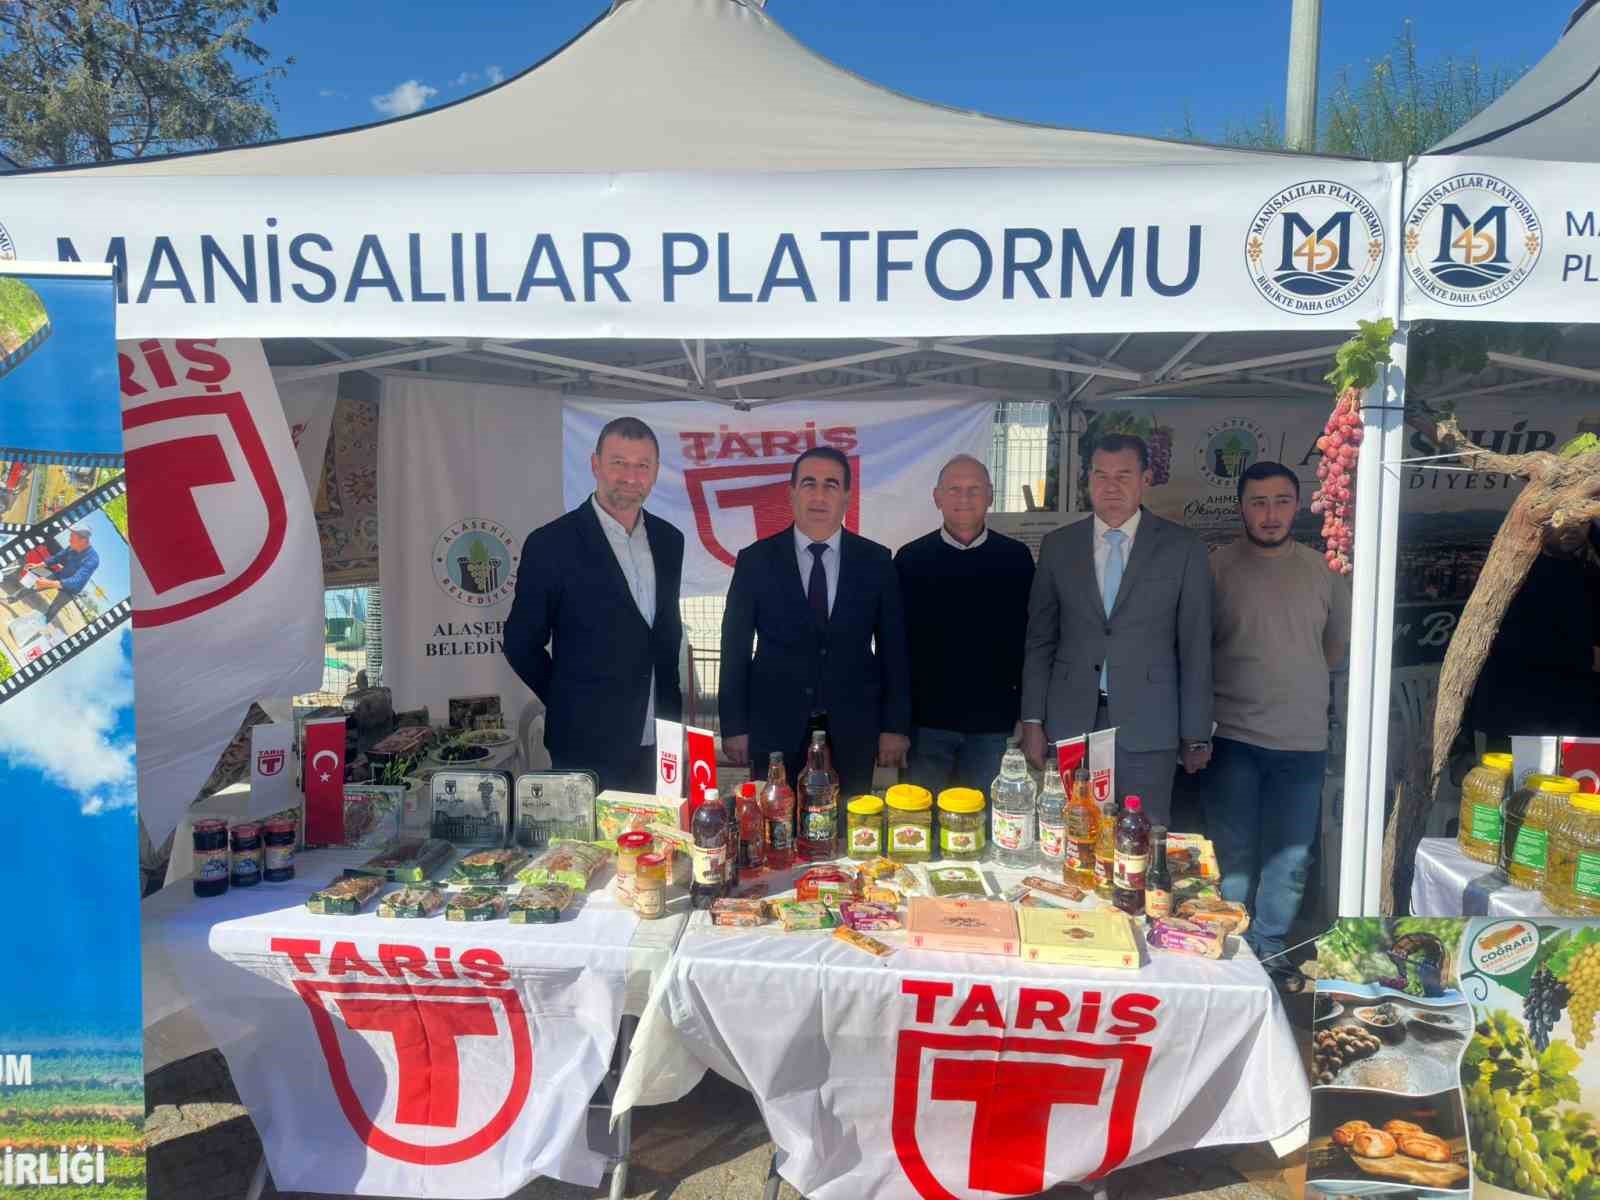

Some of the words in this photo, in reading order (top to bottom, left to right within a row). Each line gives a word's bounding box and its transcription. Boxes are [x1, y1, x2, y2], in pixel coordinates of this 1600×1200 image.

[1329, 185, 1382, 239] PLATFORMU
[1486, 179, 1538, 232] PLATFORMU
[1566, 210, 1600, 237] M
[662, 225, 1202, 302] PLATFORMU
[1296, 300, 1323, 311] DAHA
[1449, 292, 1477, 303] DAHA
[1480, 932, 1533, 963] COĞRAFİ
